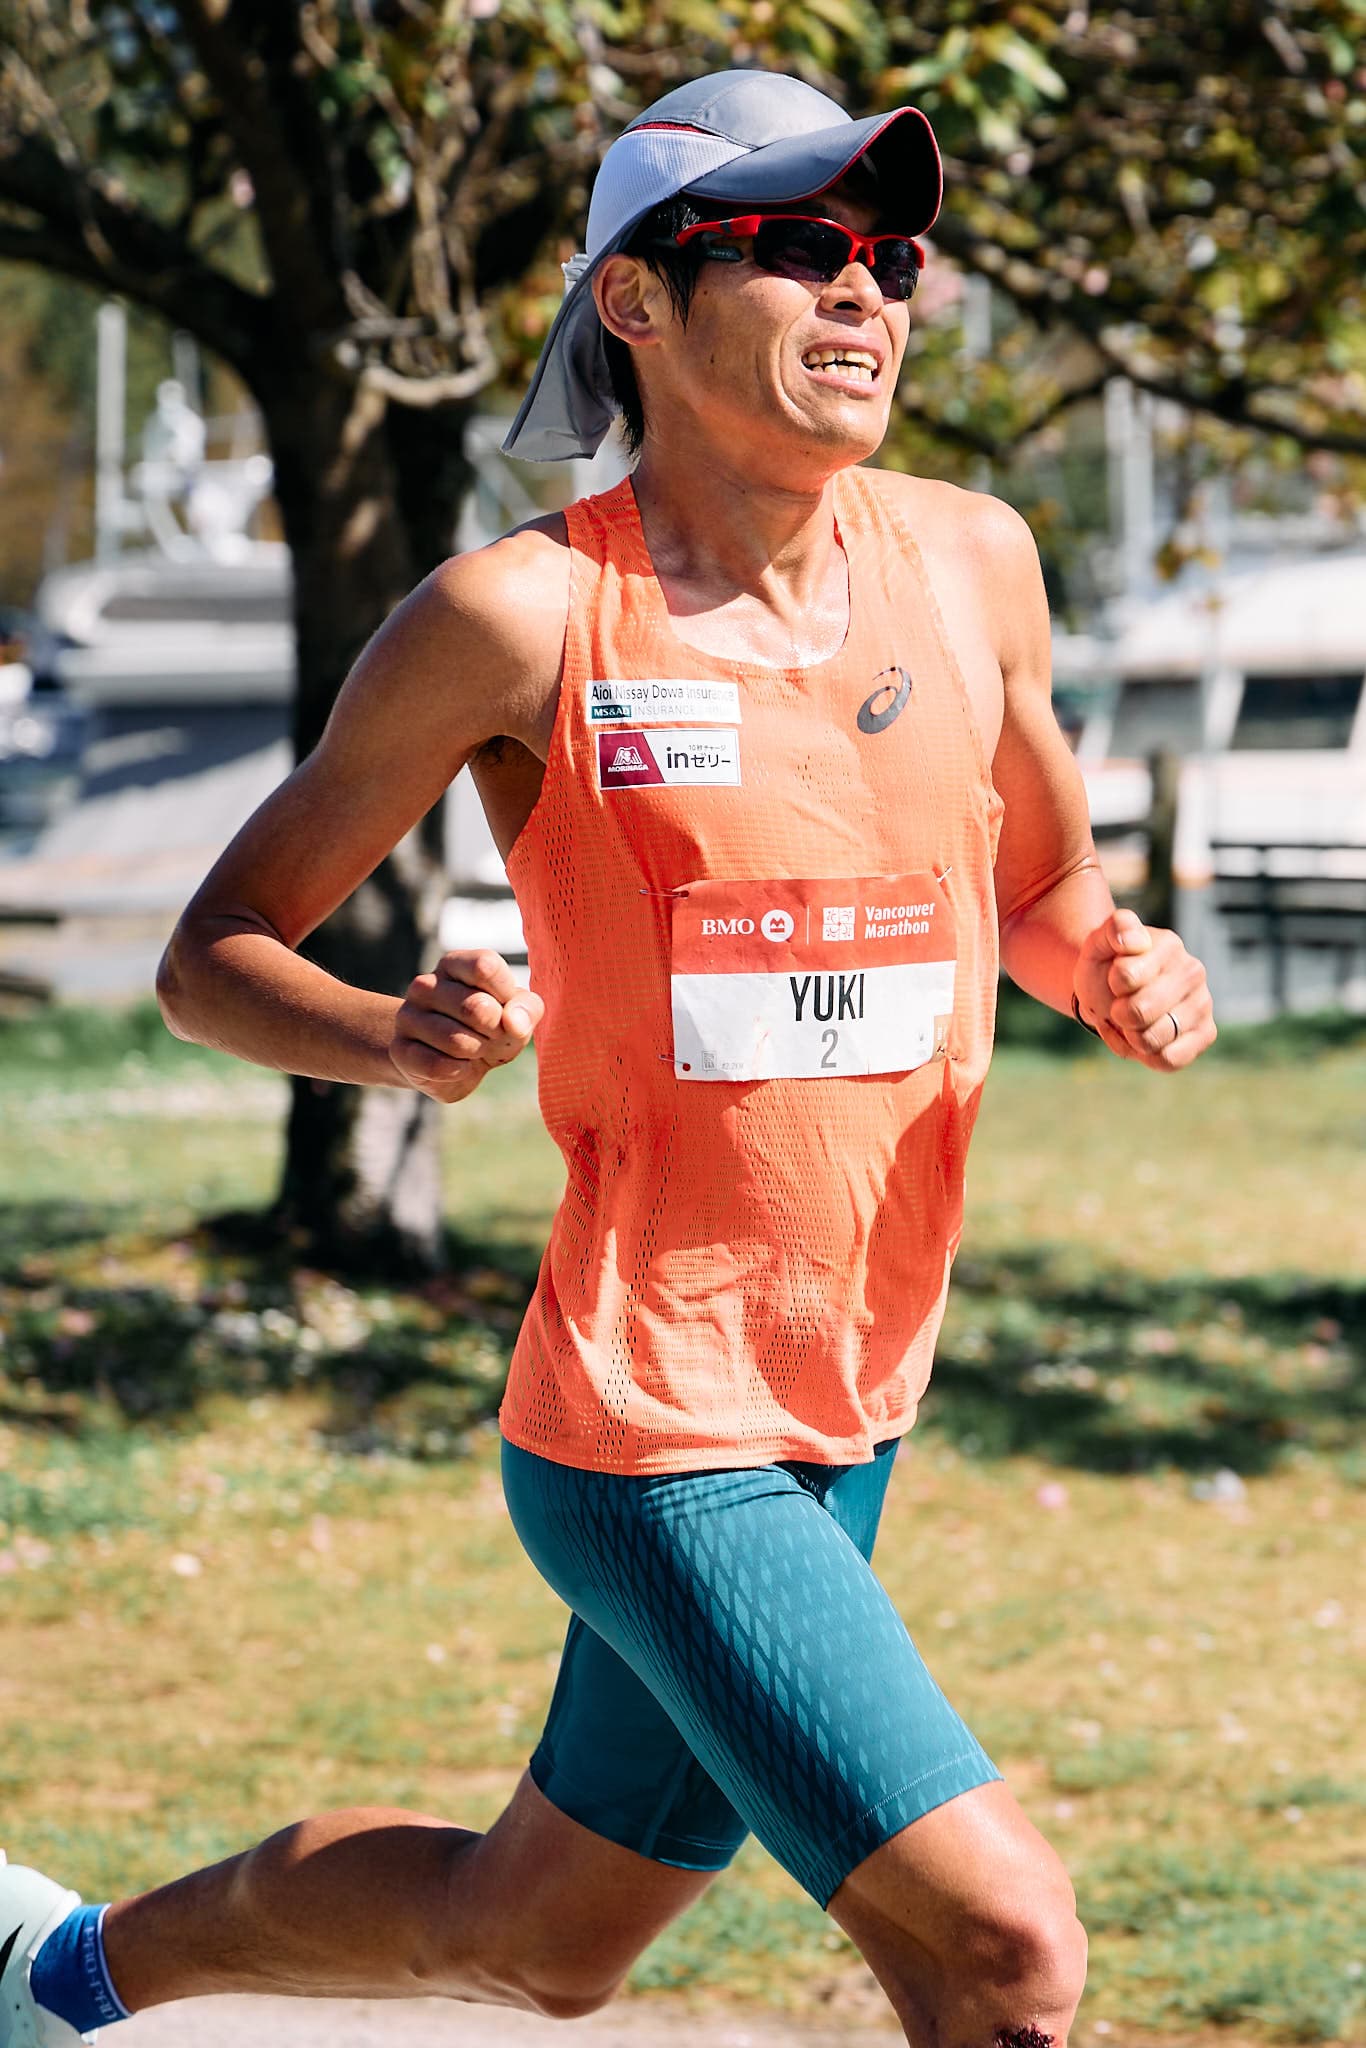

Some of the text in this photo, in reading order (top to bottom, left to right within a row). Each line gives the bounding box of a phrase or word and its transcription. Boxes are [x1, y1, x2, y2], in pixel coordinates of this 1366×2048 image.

[591, 685, 612, 701] Aioi
[615, 685, 649, 703] Nissay
[652, 685, 684, 699] Dowa
[593, 707, 630, 717] MS&AD
[864, 903, 936, 922] Vancouver
[701, 918, 755, 935] BMO
[864, 918, 930, 940] Marathon
[789, 973, 866, 1022] YUKI
[820, 1028, 840, 1069] 2
